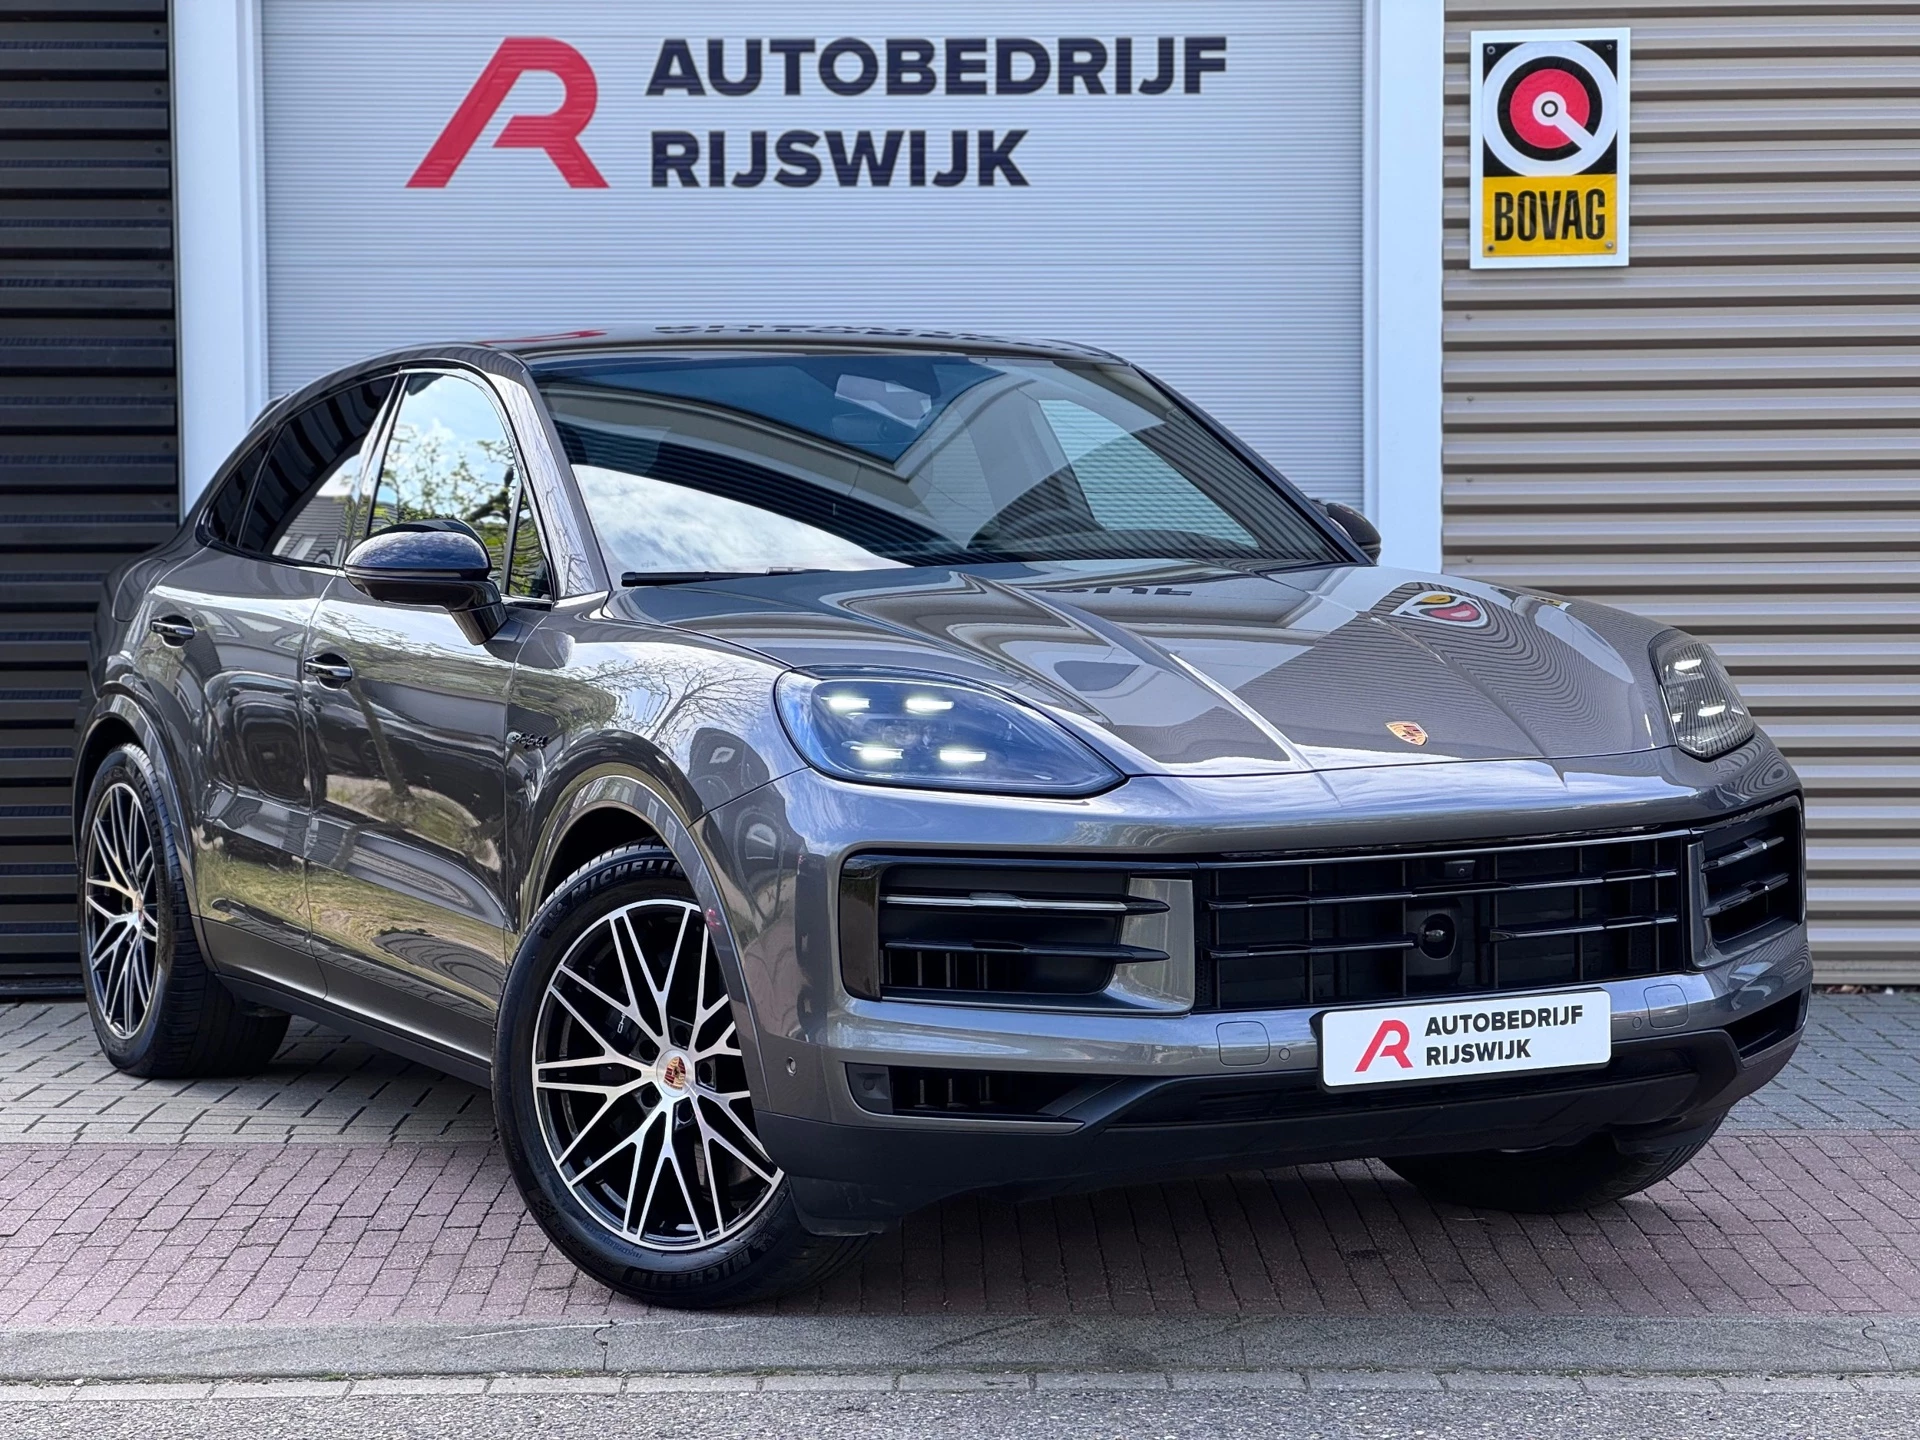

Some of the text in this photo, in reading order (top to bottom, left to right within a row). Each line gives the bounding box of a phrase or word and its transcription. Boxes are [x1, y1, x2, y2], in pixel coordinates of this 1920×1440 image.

[645, 37, 1227, 96] AUTOBEDRIJF
[651, 129, 1031, 188] RIJSWIJK
[1494, 188, 1606, 242] BOVAG
[1424, 1004, 1583, 1037] AUTOBEDRIJF
[1426, 1038, 1532, 1067] RIJSWIJK
